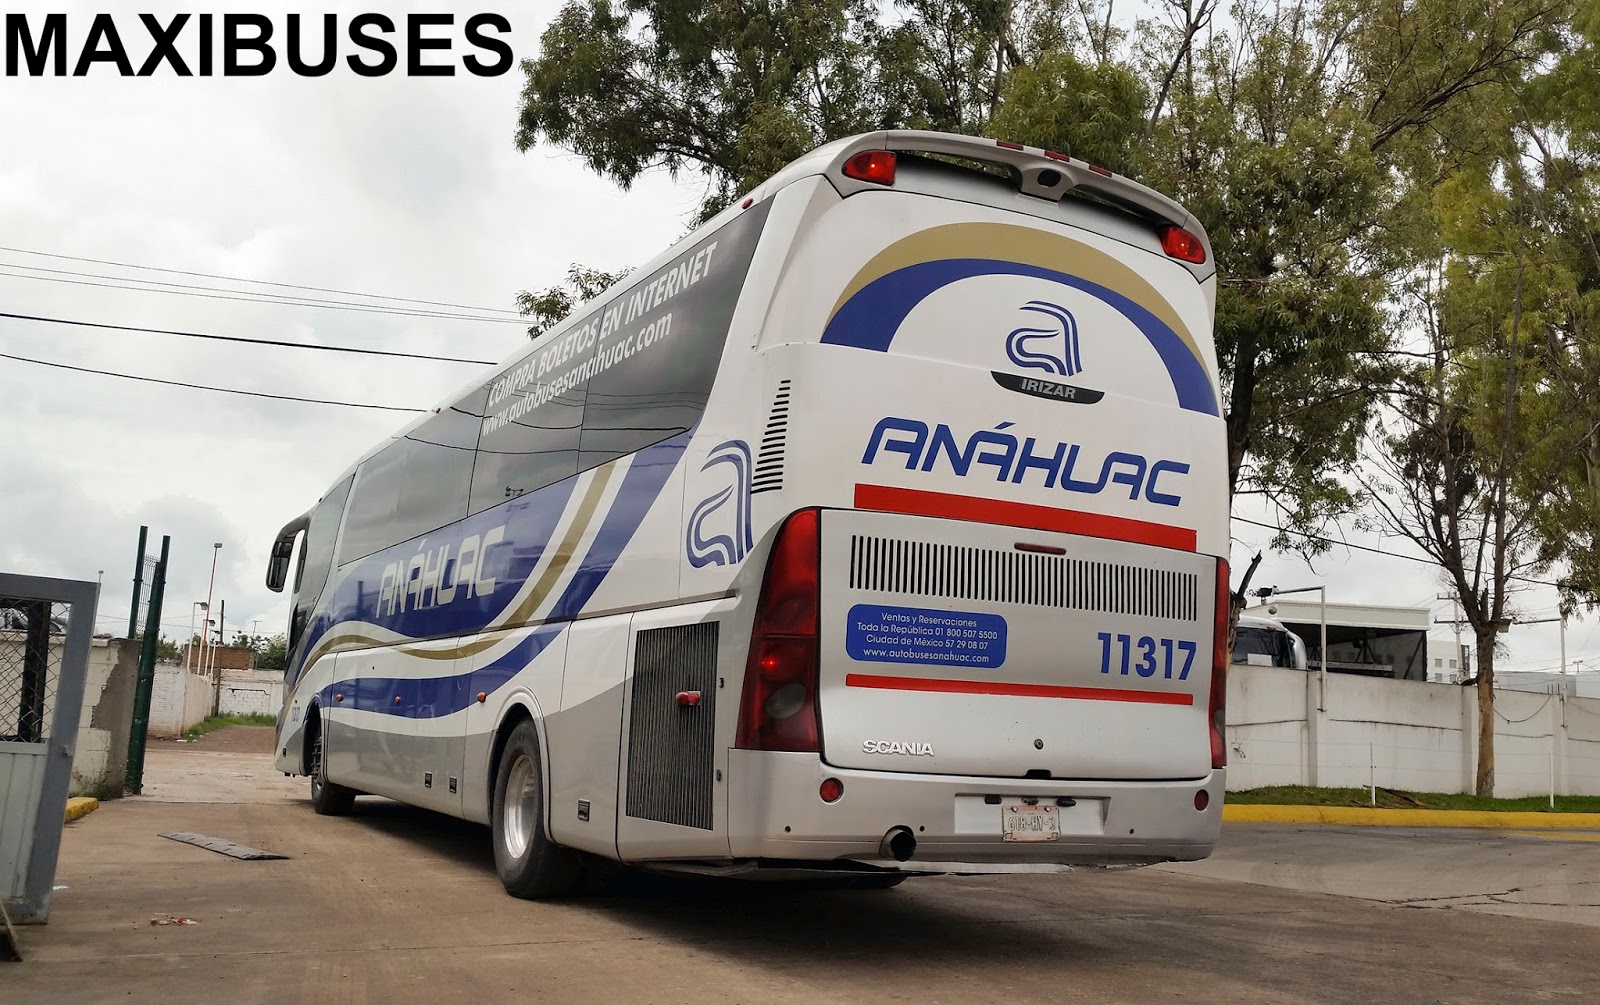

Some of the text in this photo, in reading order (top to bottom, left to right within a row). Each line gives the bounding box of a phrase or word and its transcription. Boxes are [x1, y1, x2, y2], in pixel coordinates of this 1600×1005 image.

[488, 240, 718, 407] COMPRA BOLETOS EN INTERNET
[482, 312, 672, 437] www.autobusesanahuac.com
[1020, 378, 1076, 399] IRIZAR
[861, 416, 1191, 507] ANÁHUAC
[375, 525, 506, 619] ANÁHUAC
[881, 612, 977, 627] Ventas y Reservaciones
[857, 622, 879, 632] Toda
[880, 623, 889, 633] la
[891, 625, 933, 636] República
[947, 629, 961, 637] 800
[963, 630, 977, 638] 507
[979, 631, 998, 639] 5500
[866, 634, 988, 650] Ciudad de México 57 29 08 07
[863, 648, 989, 663] www.autobusesanahuac.com
[1097, 632, 1197, 680] 11317
[862, 739, 935, 757] SCANIA
